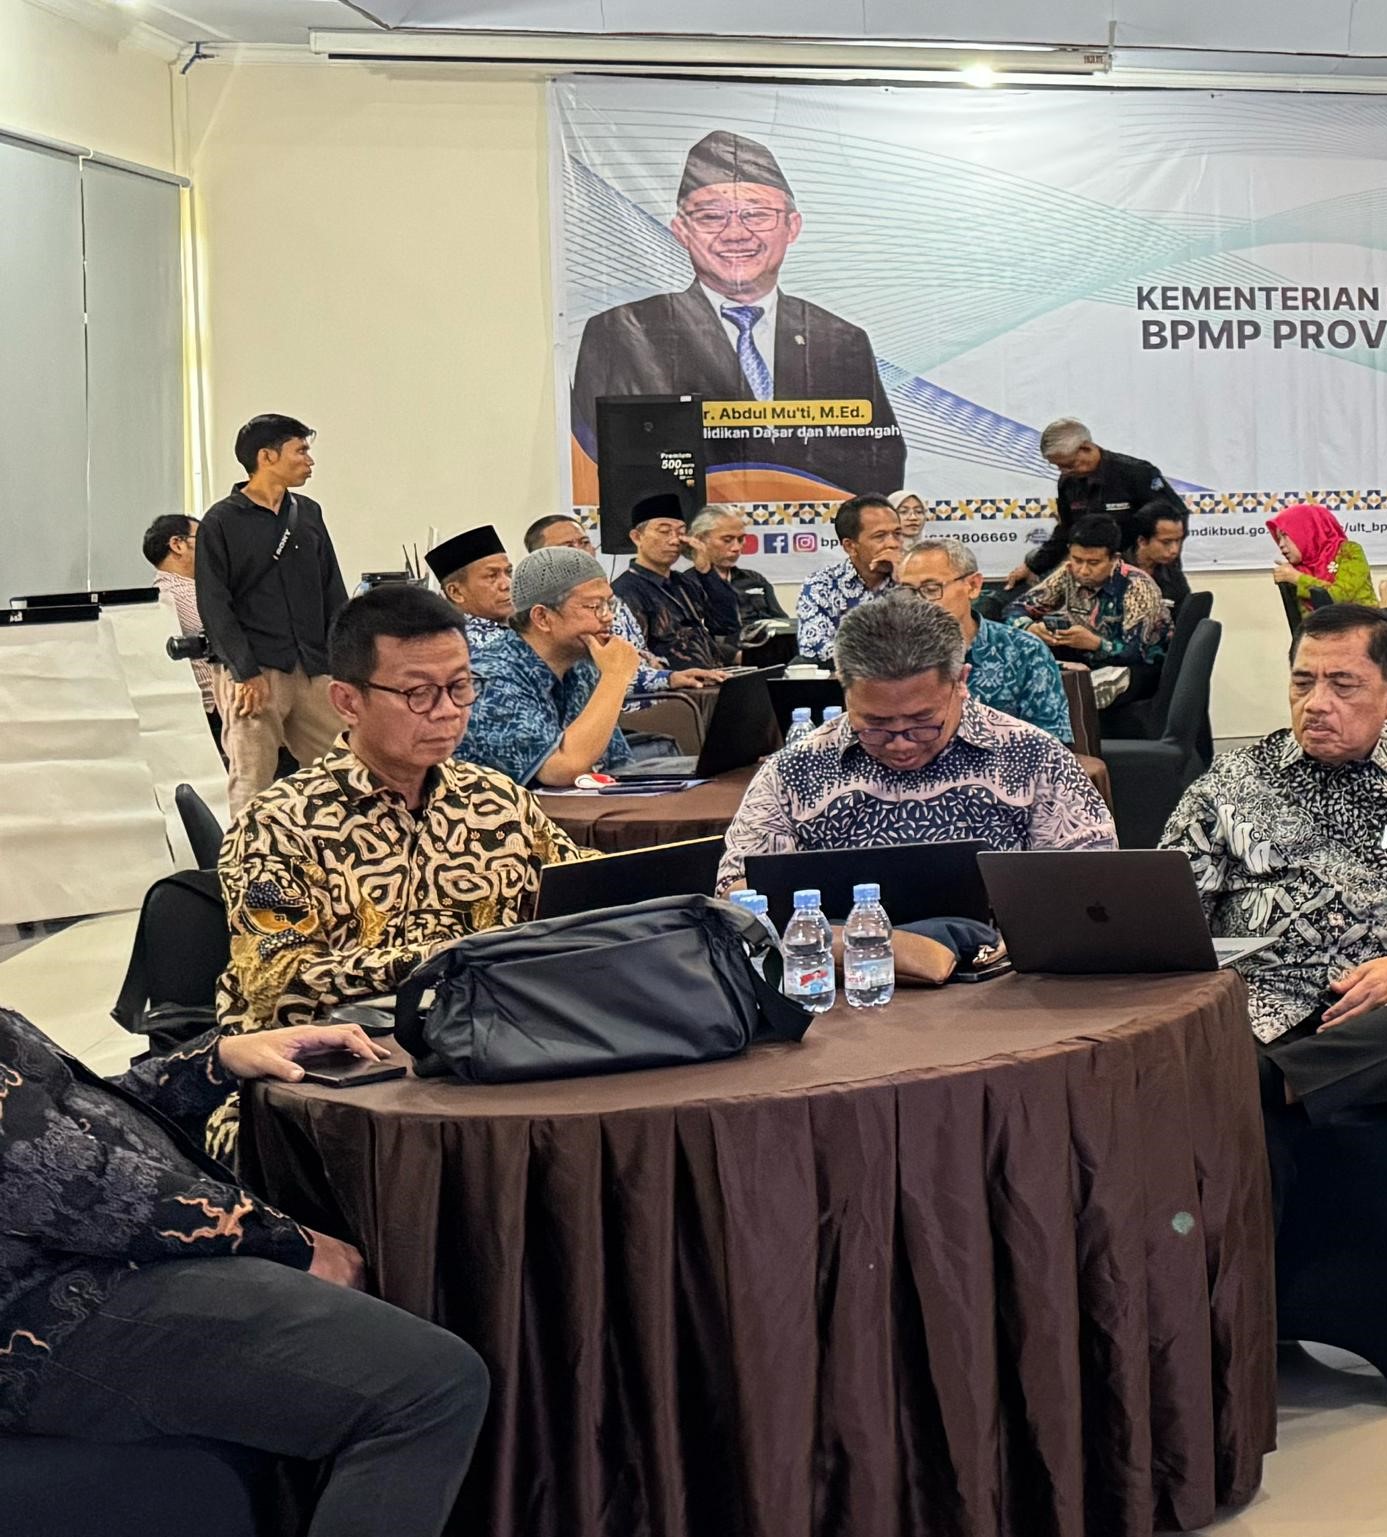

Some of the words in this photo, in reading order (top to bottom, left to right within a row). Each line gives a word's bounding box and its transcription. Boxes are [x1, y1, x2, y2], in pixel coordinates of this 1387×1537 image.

[1136, 286, 1379, 311] KEMENTERIAN
[1141, 319, 1262, 350] BPMP
[703, 410, 715, 420] r.
[719, 407, 767, 420] Abdul
[771, 405, 816, 421] Mu'ti,
[820, 405, 865, 419] M.Ed.
[753, 426, 793, 438] Dasar
[797, 426, 824, 438] dan
[826, 425, 900, 439] Menengah
